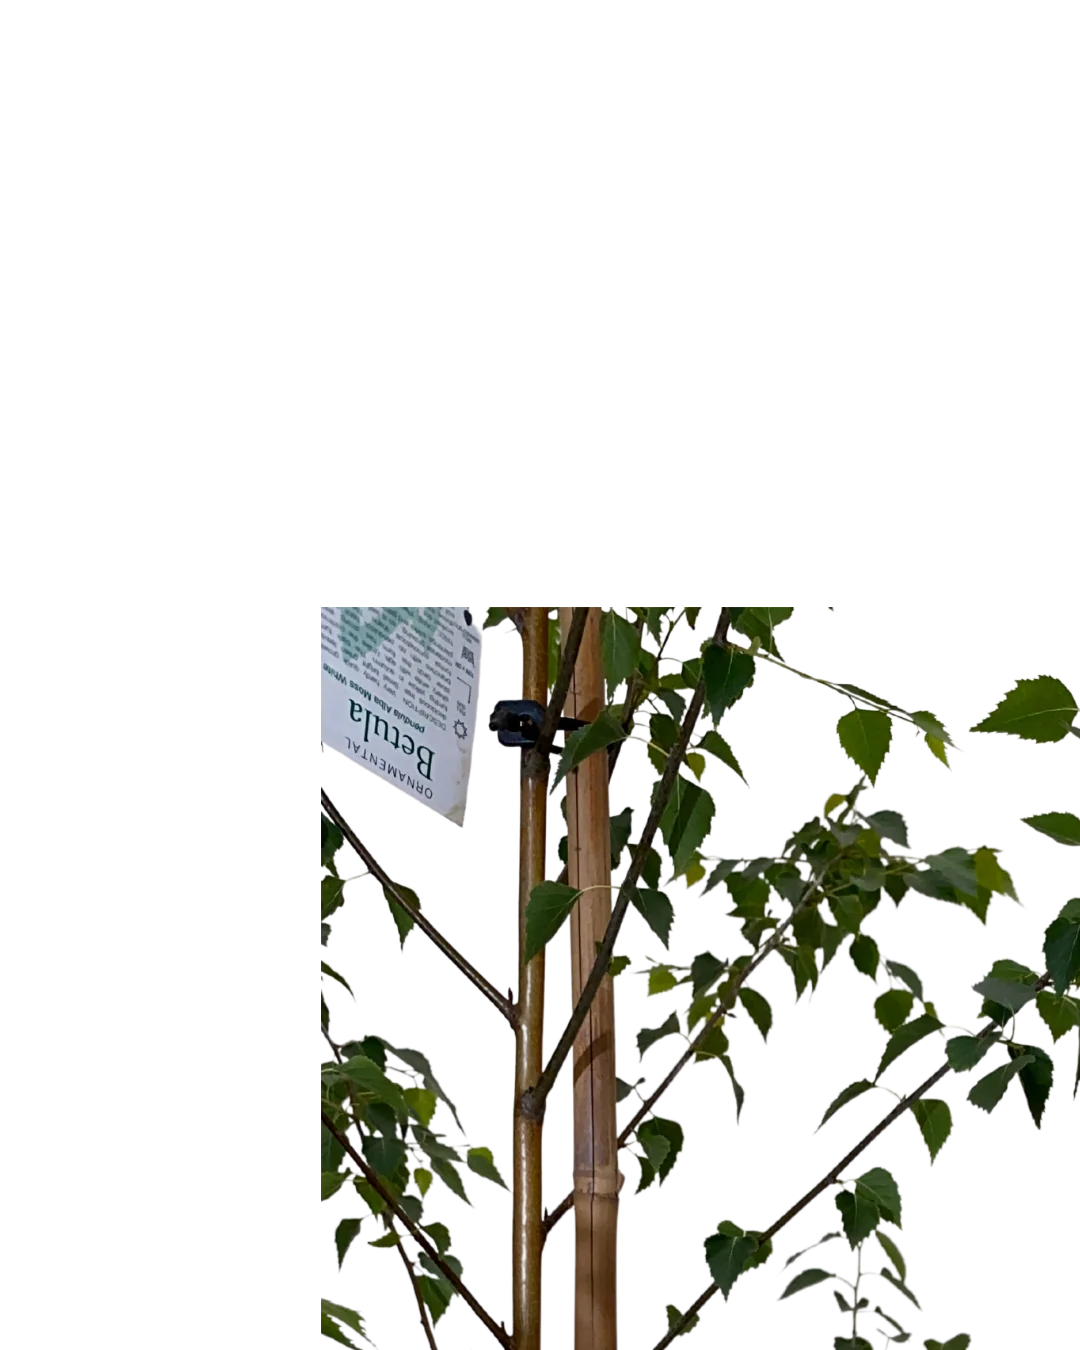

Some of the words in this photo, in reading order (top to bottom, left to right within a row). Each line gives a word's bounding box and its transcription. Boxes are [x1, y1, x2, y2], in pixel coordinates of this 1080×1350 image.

[323, 662, 346, 685] White
[349, 679, 371, 701] Moss
[374, 695, 392, 714] Alba
[393, 707, 424, 734] pendula
[348, 697, 435, 782] Betula
[344, 735, 432, 800] ORNAMENTAL
